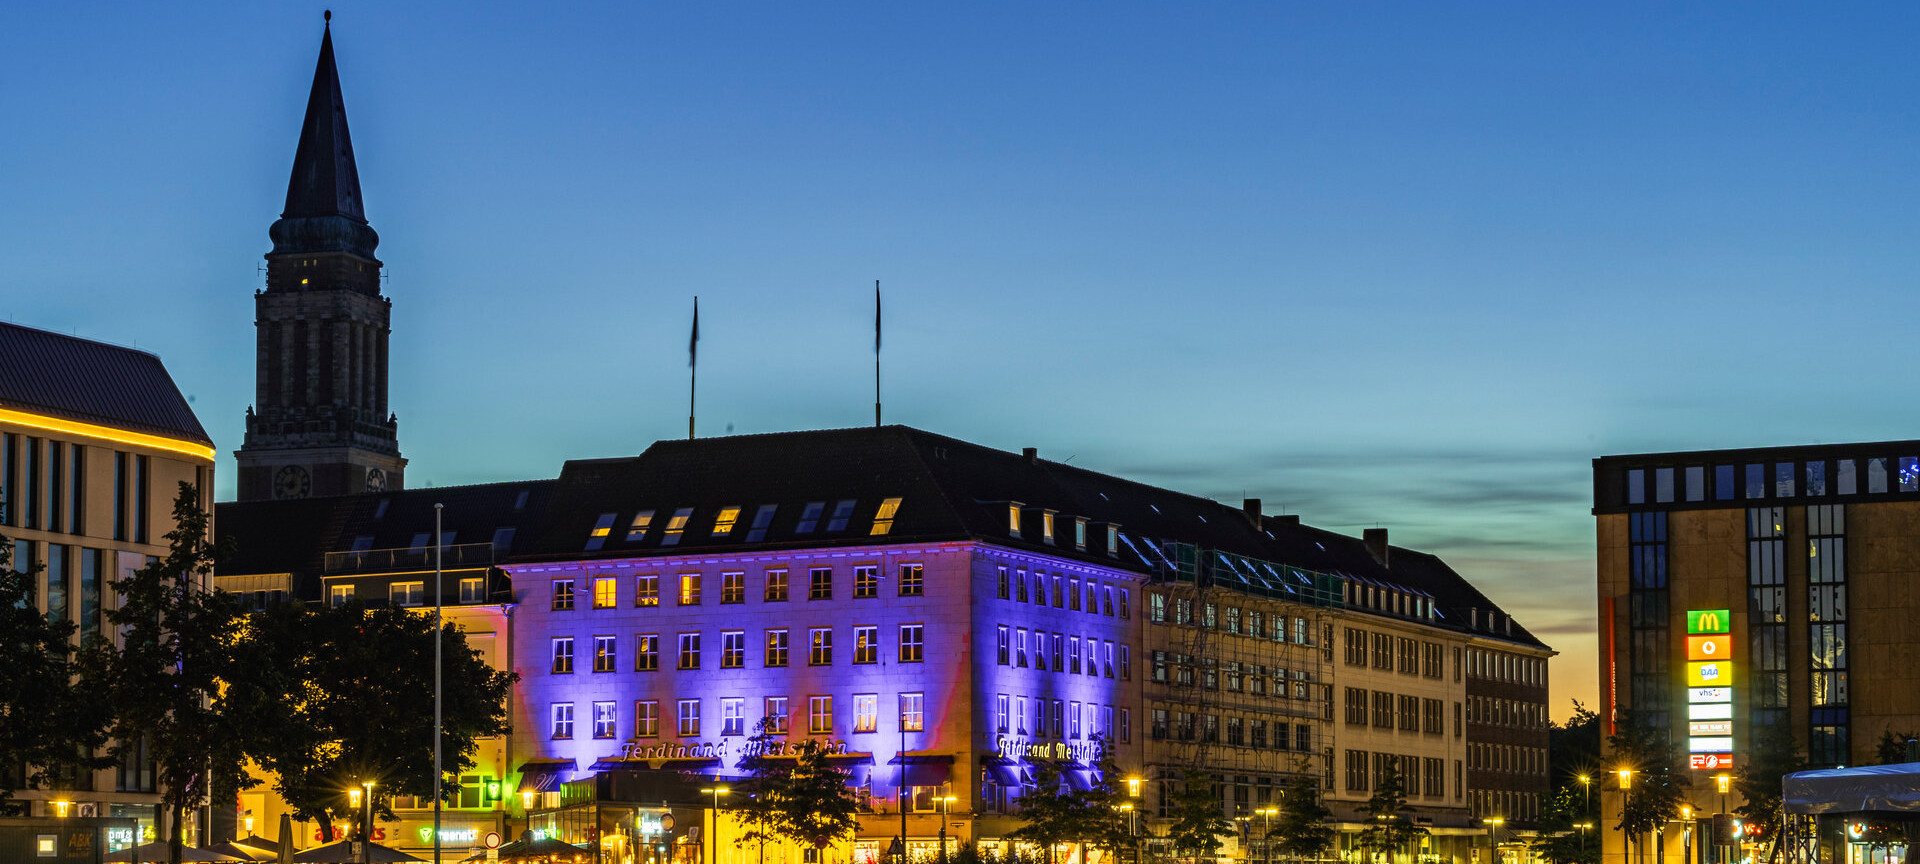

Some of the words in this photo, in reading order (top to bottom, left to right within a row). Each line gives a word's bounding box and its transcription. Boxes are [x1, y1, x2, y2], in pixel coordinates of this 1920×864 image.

[1700, 668, 1719, 676] DAA
[1698, 689, 1713, 697] vhs
[619, 739, 728, 762] Ferdinand
[998, 737, 1051, 758] Ferdinand
[69, 832, 93, 848] ABK
